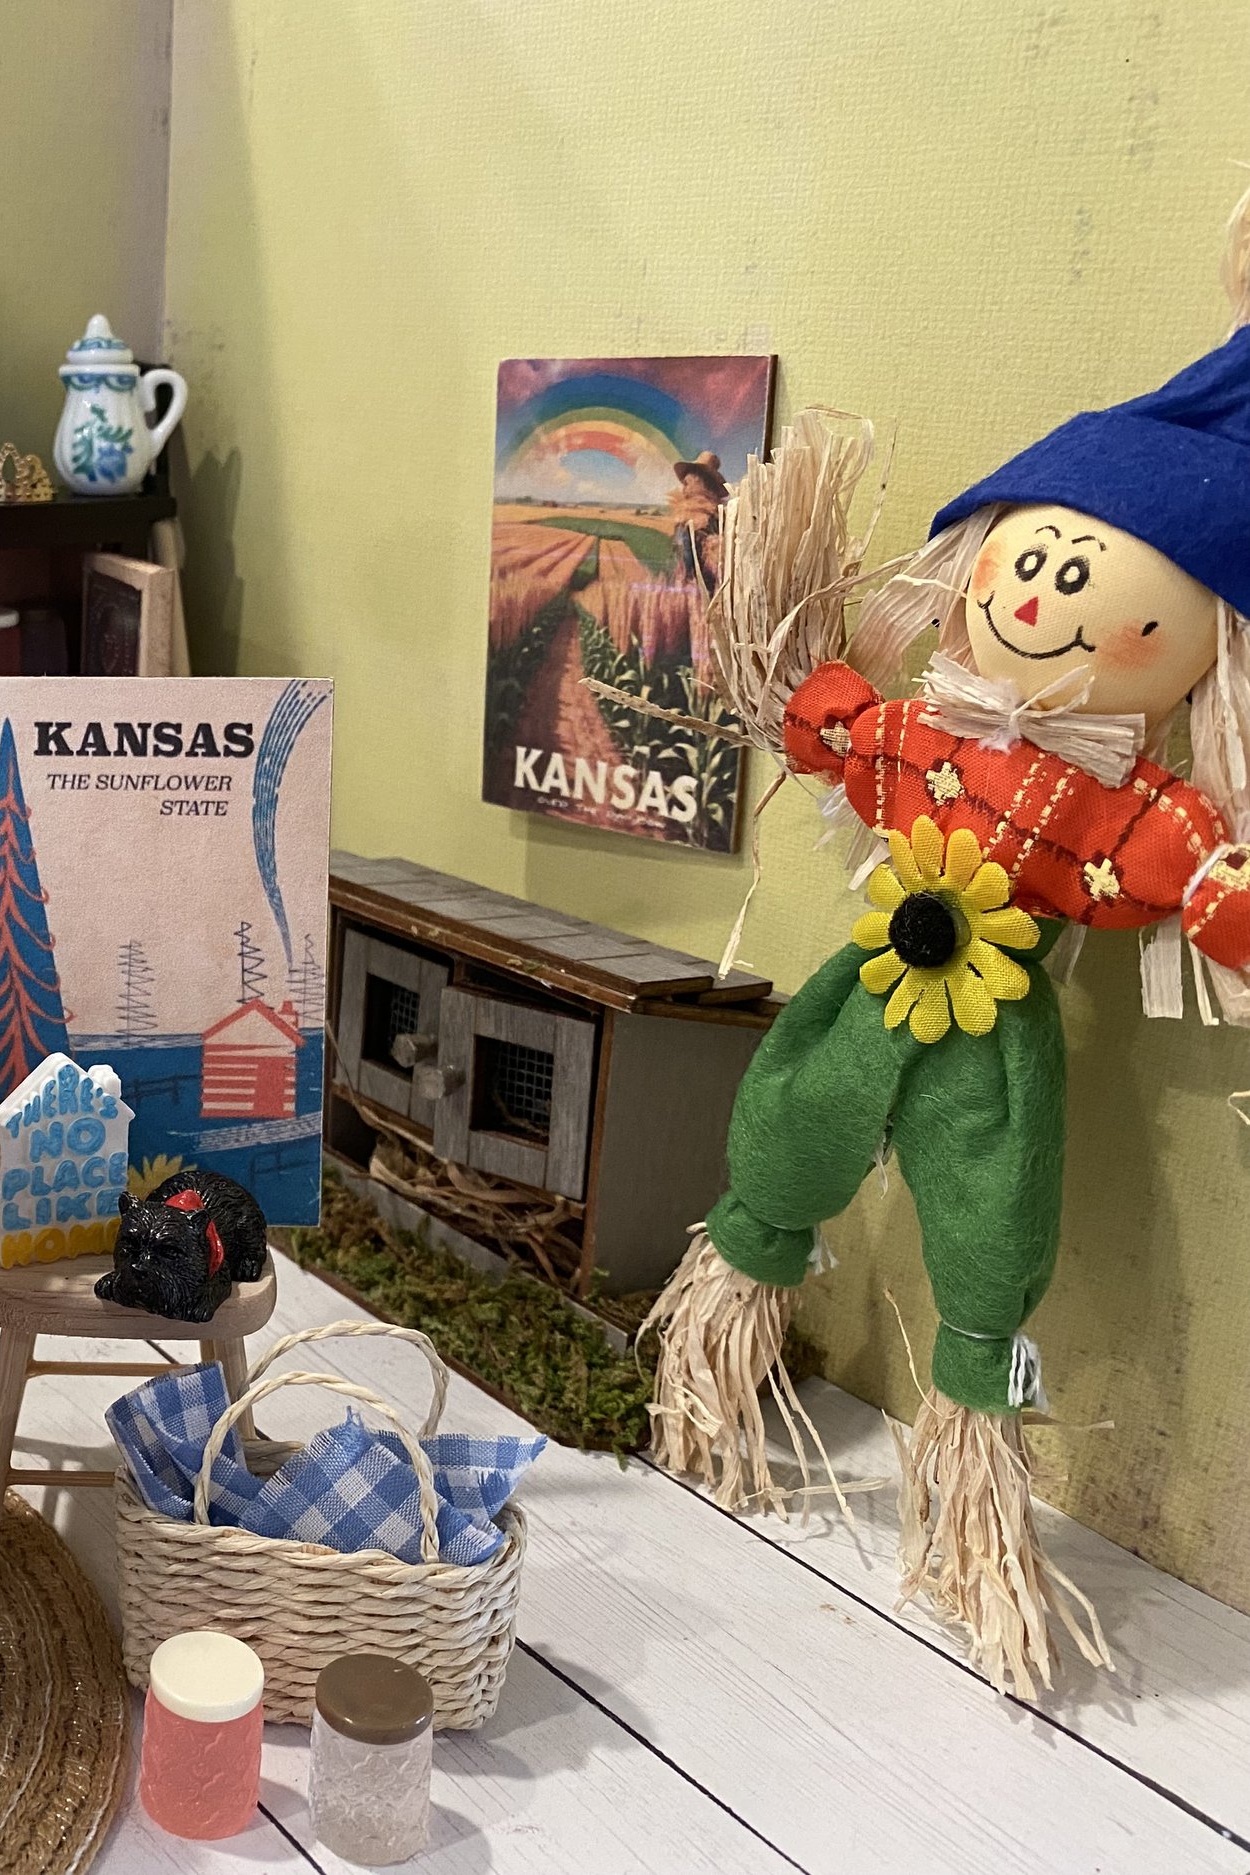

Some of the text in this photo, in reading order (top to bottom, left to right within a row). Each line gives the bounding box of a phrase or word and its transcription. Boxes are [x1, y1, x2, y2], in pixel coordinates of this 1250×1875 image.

[33, 721, 255, 758] KANSAS
[47, 774, 233, 792] THE SUNFLOWER
[514, 746, 699, 823] KANSAS
[159, 800, 229, 817] STATE
[5, 1064, 119, 1139] THERE'S
[29, 1117, 106, 1163] NO
[2, 1152, 128, 1201] PLACE
[2, 1187, 123, 1231] LIKE
